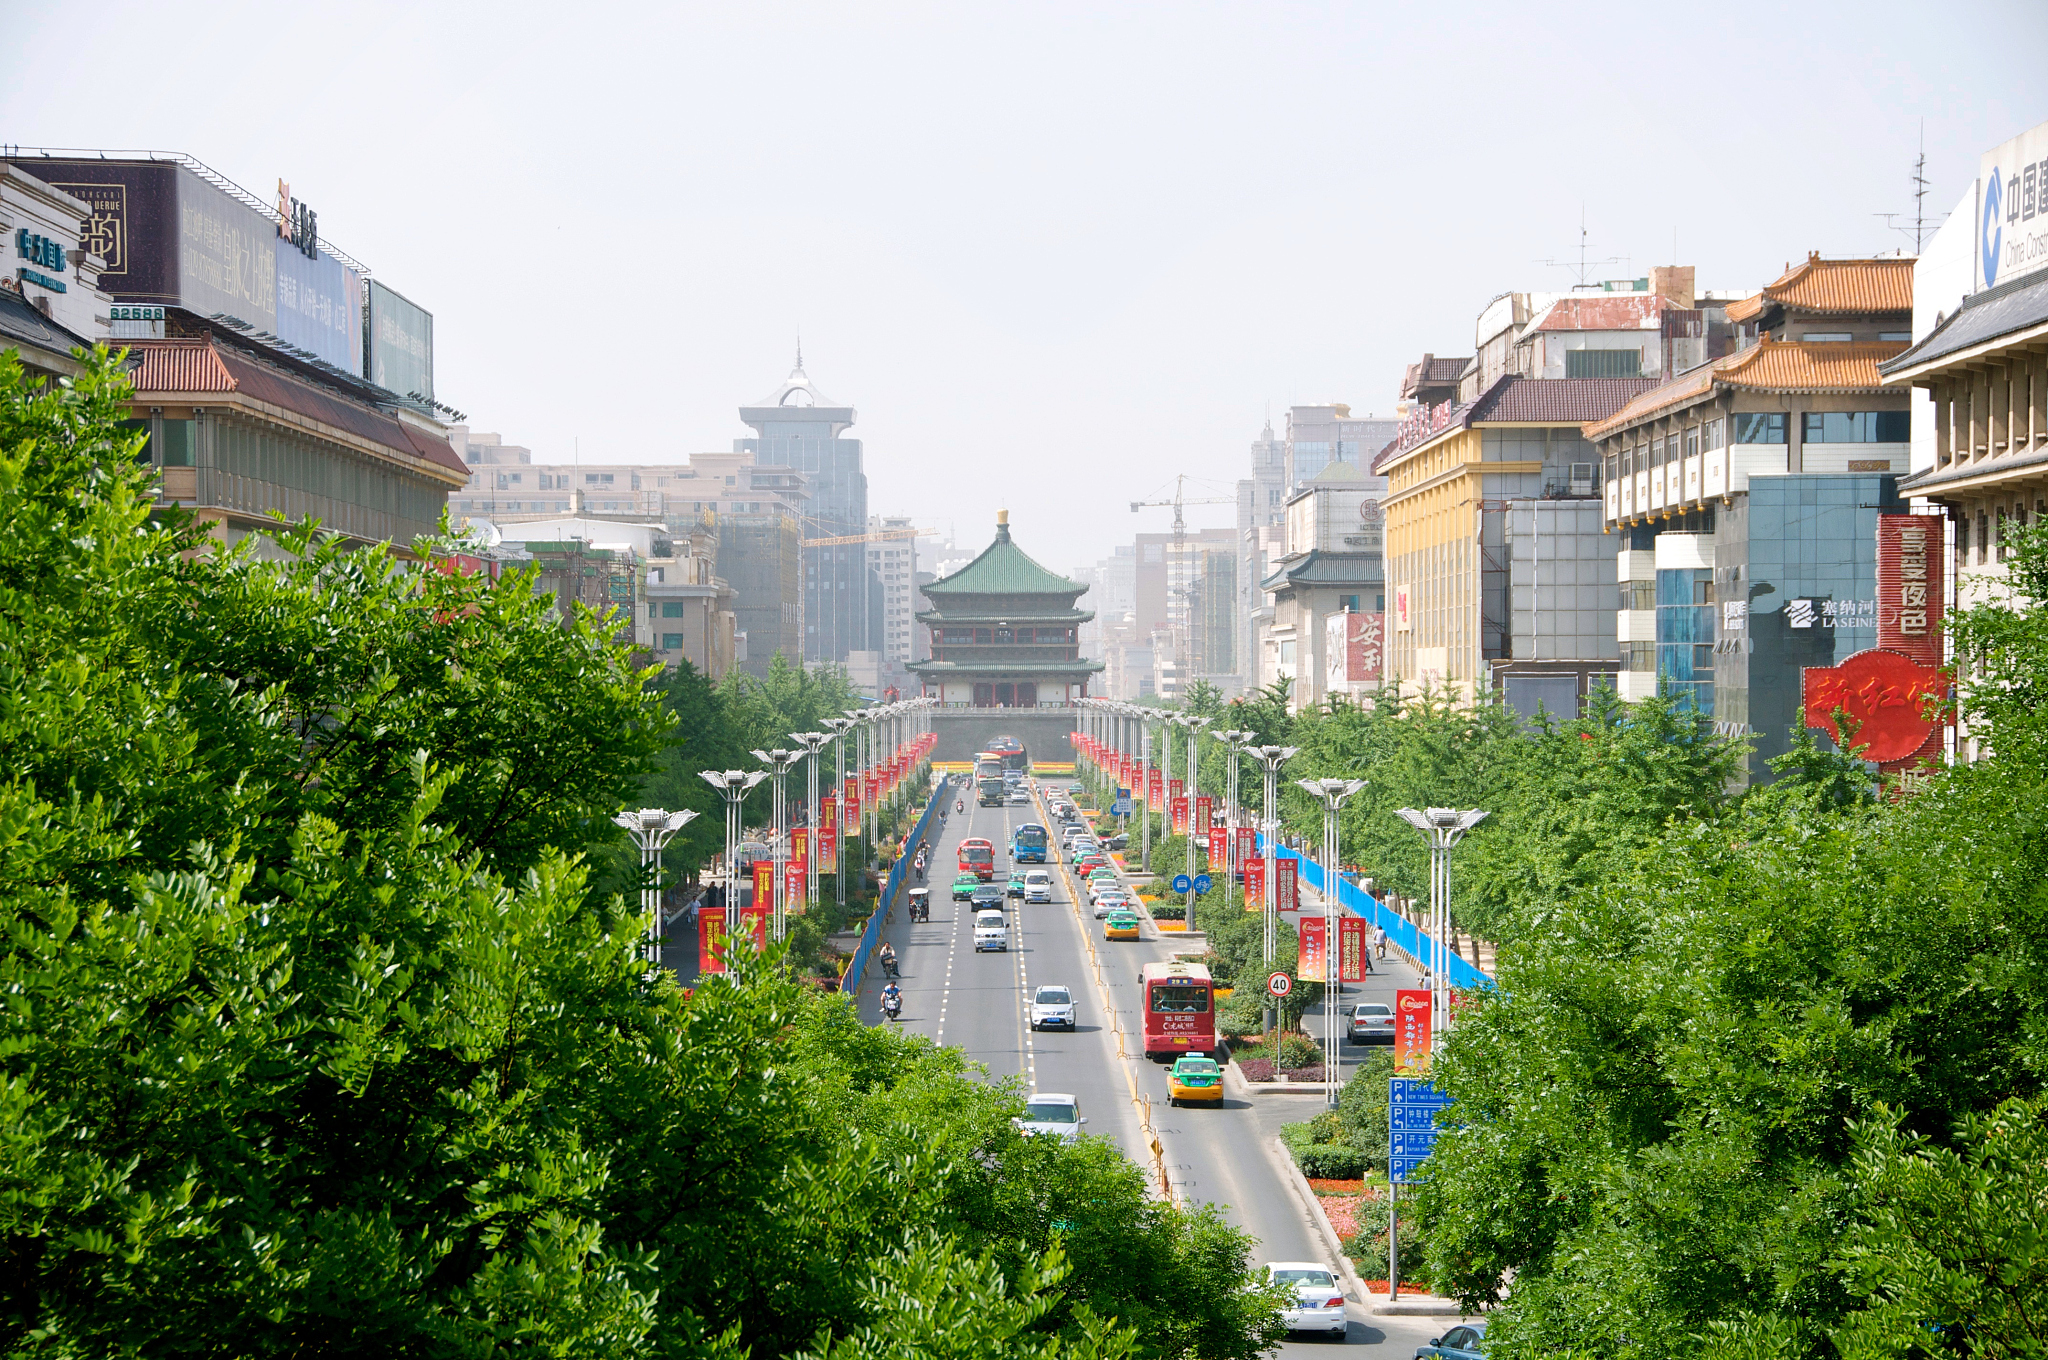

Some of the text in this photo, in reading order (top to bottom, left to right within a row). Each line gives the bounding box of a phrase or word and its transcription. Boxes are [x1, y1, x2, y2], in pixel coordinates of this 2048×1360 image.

[2006, 238, 2024, 267] China
[1900, 527, 1927, 635] 享受夜色
[1822, 599, 1874, 615] 塞纳河
[1822, 617, 1839, 628] LA
[1272, 979, 1287, 990] 40
[1403, 1014, 1416, 1067] 陕西都市广播
[1394, 1082, 1403, 1092] P
[1394, 1108, 1403, 1118] P
[1394, 1134, 1403, 1144] P
[1394, 1160, 1402, 1170] P
